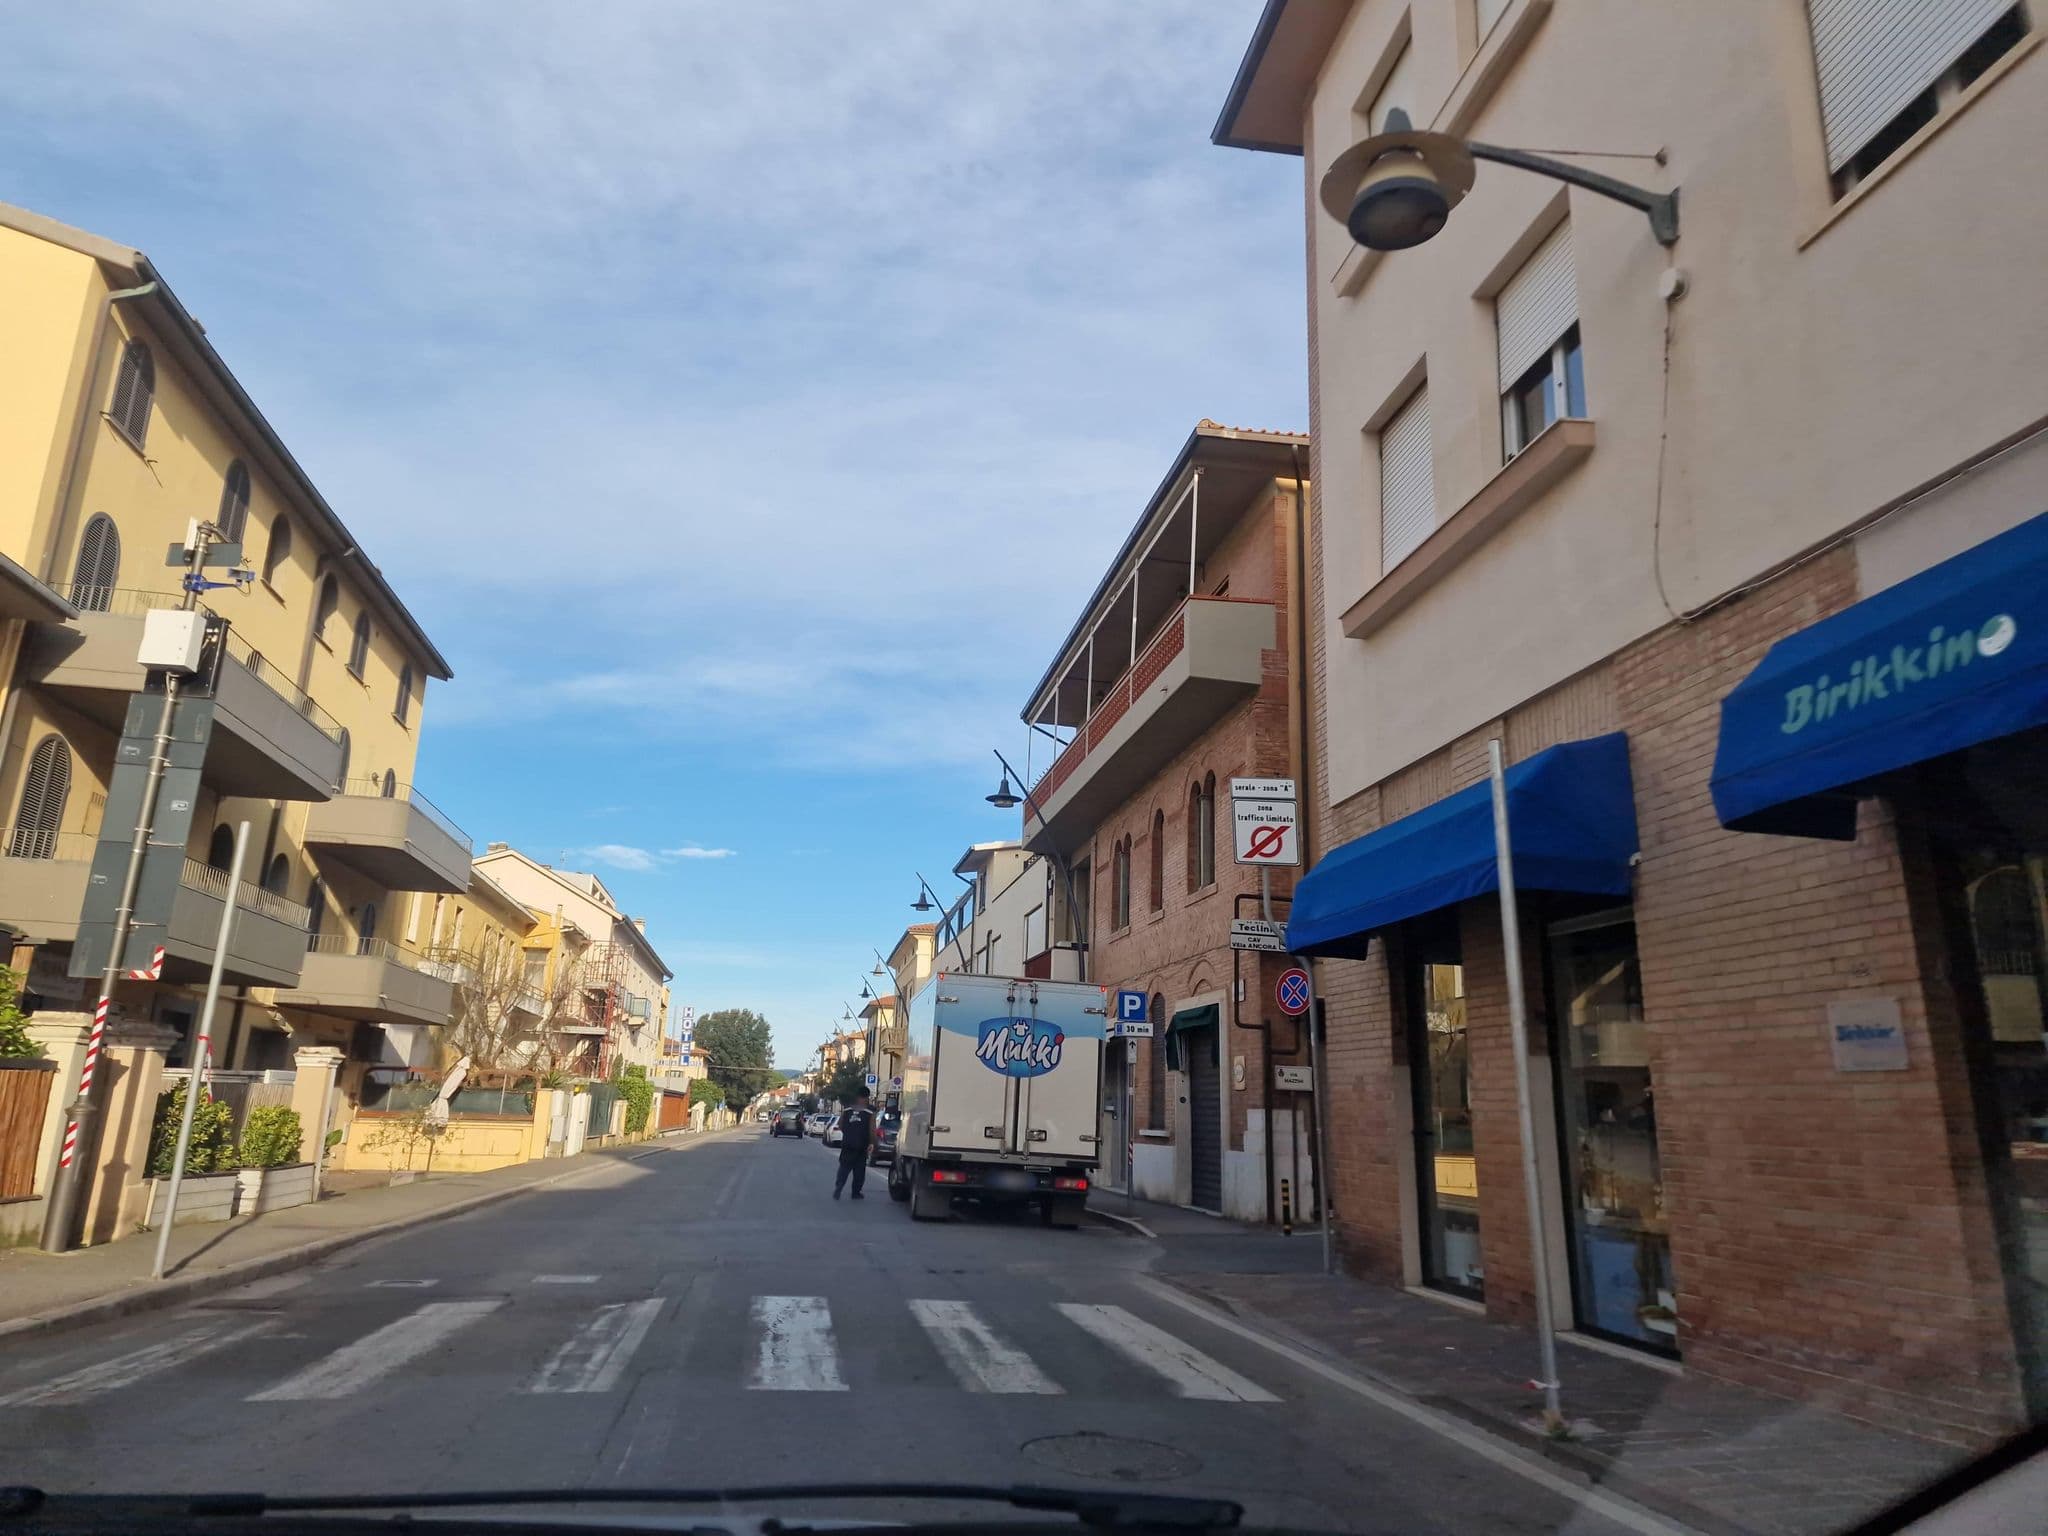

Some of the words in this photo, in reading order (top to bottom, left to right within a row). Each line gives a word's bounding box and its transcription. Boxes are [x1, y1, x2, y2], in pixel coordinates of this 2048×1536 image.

[1237, 814, 1264, 822] traffico
[1265, 815, 1294, 823] limitato
[1123, 994, 1142, 1018] P
[681, 1007, 694, 1066] HOTEL
[1126, 1025, 1135, 1033] 30
[1137, 1025, 1149, 1033] min
[975, 1026, 1065, 1069] Mukki
